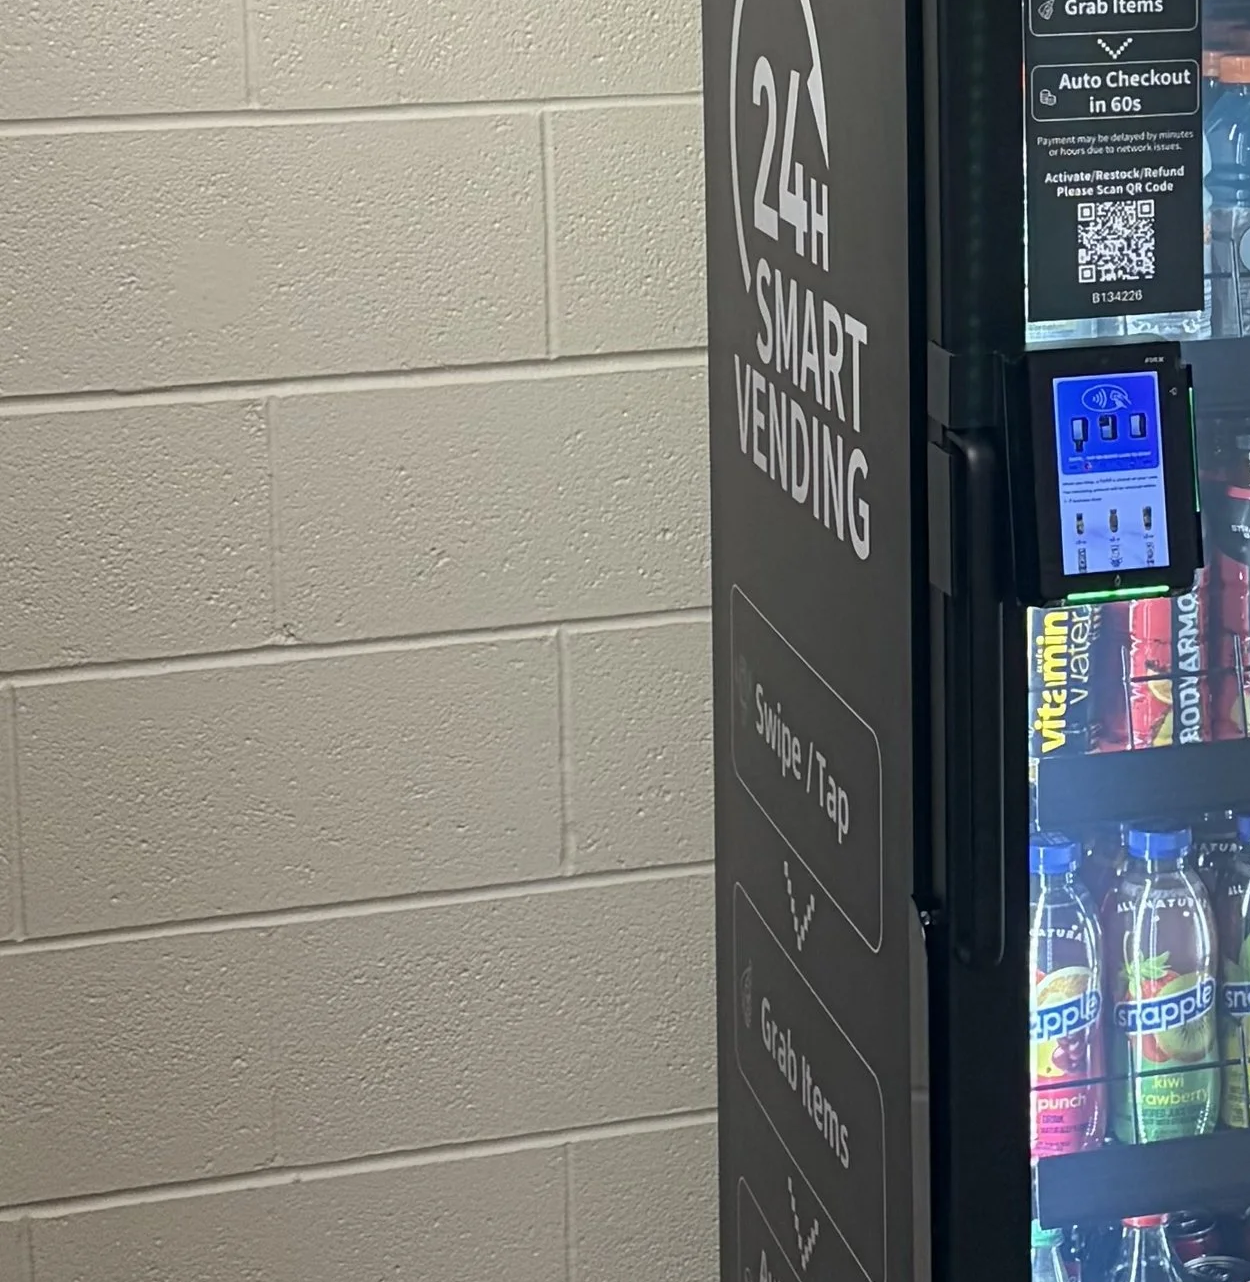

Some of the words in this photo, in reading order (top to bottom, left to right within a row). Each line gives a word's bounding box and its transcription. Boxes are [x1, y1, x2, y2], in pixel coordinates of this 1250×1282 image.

[1059, 73, 1102, 90] Auto
[1106, 69, 1192, 88] Checkout
[1089, 96, 1107, 113] in
[1111, 96, 1142, 112] 60s
[1037, 135, 1075, 147] Payment
[1077, 135, 1096, 145] may
[1098, 133, 1109, 142] be
[1110, 131, 1145, 143] delayed
[1146, 131, 1157, 141] by
[1159, 130, 1194, 139] minutes
[1049, 149, 1058, 157] or
[1060, 147, 1085, 156] hours
[1087, 146, 1103, 155] due
[1105, 145, 1114, 154] to
[1116, 144, 1152, 153] network
[752, 55, 830, 272] 24H
[1044, 165, 1185, 184] Activate/Restock/Refund
[1057, 185, 1094, 197] Please
[1097, 184, 1123, 194] Scan
[1126, 182, 1142, 194] QR
[1145, 181, 1174, 192] Code
[756, 257, 868, 433] SMART
[734, 353, 869, 560] VENDING
[1033, 610, 1070, 754] vitamin
[755, 682, 801, 781] Swipe
[806, 741, 814, 794] /
[815, 750, 849, 844] Tap
[1118, 979, 1213, 1032] snapple
[761, 996, 798, 1092] Grab
[801, 1054, 849, 1169] Items
[1152, 1075, 1184, 1089] kiwi
[1037, 1093, 1087, 1113] punch
